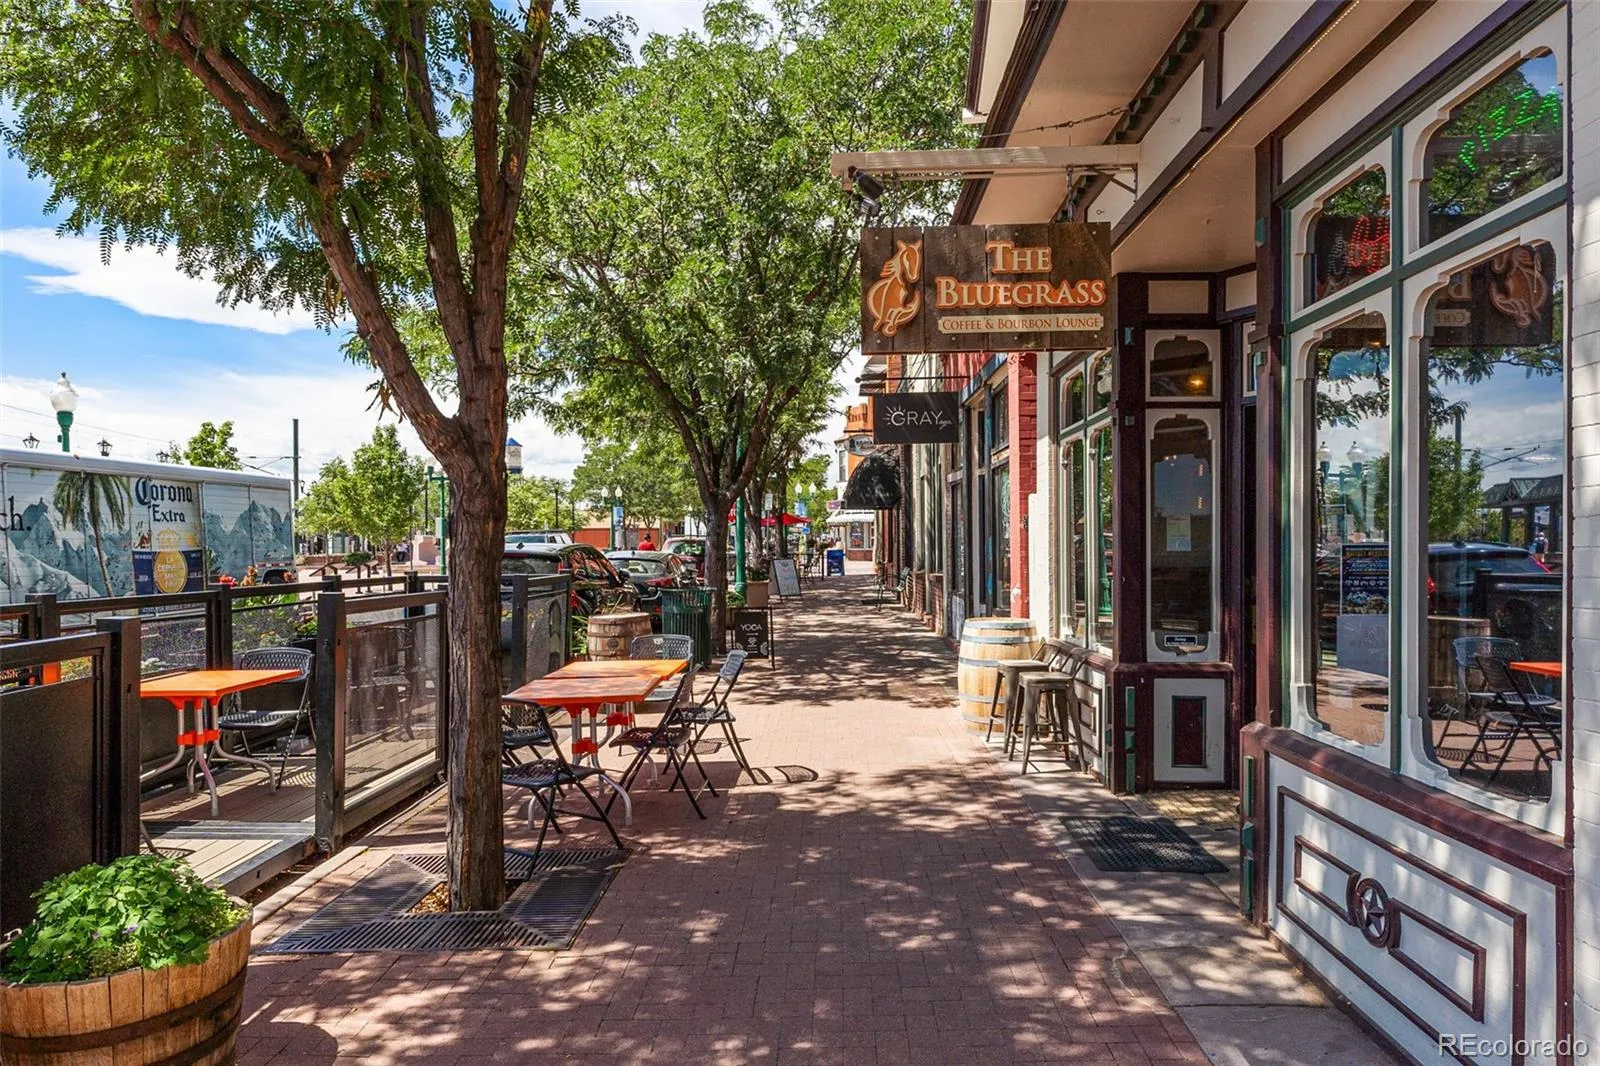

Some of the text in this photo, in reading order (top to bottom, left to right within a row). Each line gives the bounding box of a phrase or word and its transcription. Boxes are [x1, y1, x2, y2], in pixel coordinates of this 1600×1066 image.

[984, 318, 993, 329] &
[891, 410, 943, 426] GRAY
[135, 475, 193, 508] Corona
[152, 503, 186, 522] Extra
